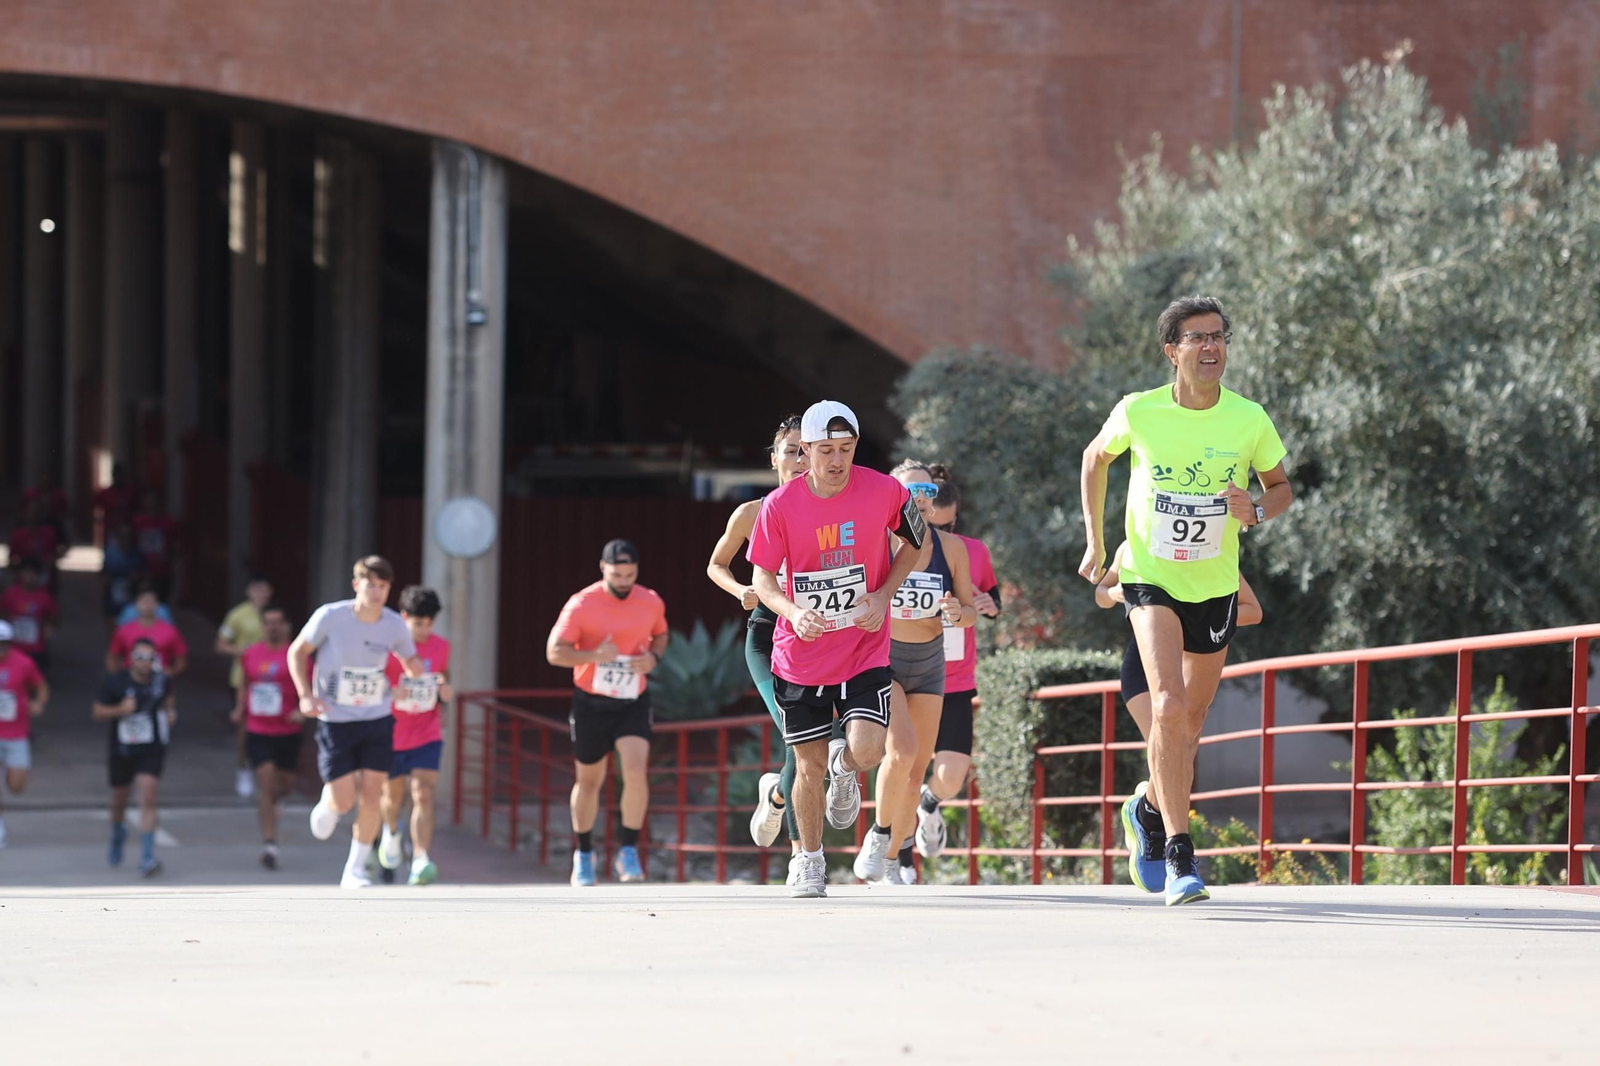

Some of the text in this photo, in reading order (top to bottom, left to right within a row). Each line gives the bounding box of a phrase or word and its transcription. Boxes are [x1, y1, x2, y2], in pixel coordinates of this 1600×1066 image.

[1157, 501, 1190, 516] UMA
[815, 521, 855, 551] WE
[1172, 519, 1206, 543] 92
[823, 551, 851, 567] RUN
[796, 581, 829, 592] UMA
[807, 588, 857, 615] 242
[892, 590, 934, 610] 530
[603, 670, 635, 685] 477
